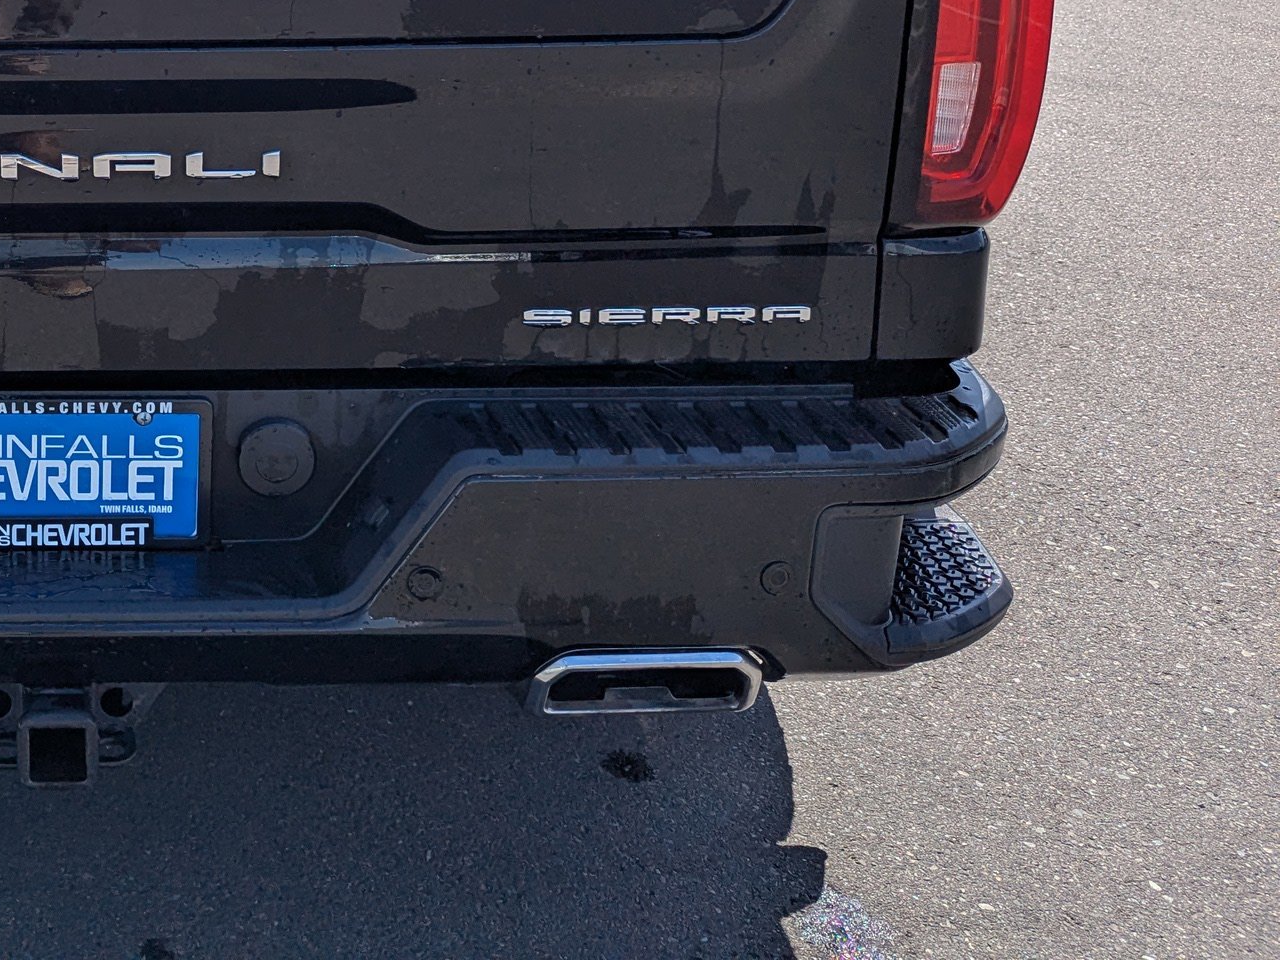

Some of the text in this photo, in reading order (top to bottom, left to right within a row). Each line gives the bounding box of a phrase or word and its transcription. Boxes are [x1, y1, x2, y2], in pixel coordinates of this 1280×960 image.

[523, 306, 812, 326] SIERRA
[99, 505, 172, 514] TWIN FALLS, IDAHO
[11, 523, 149, 546] CHEVROLET
